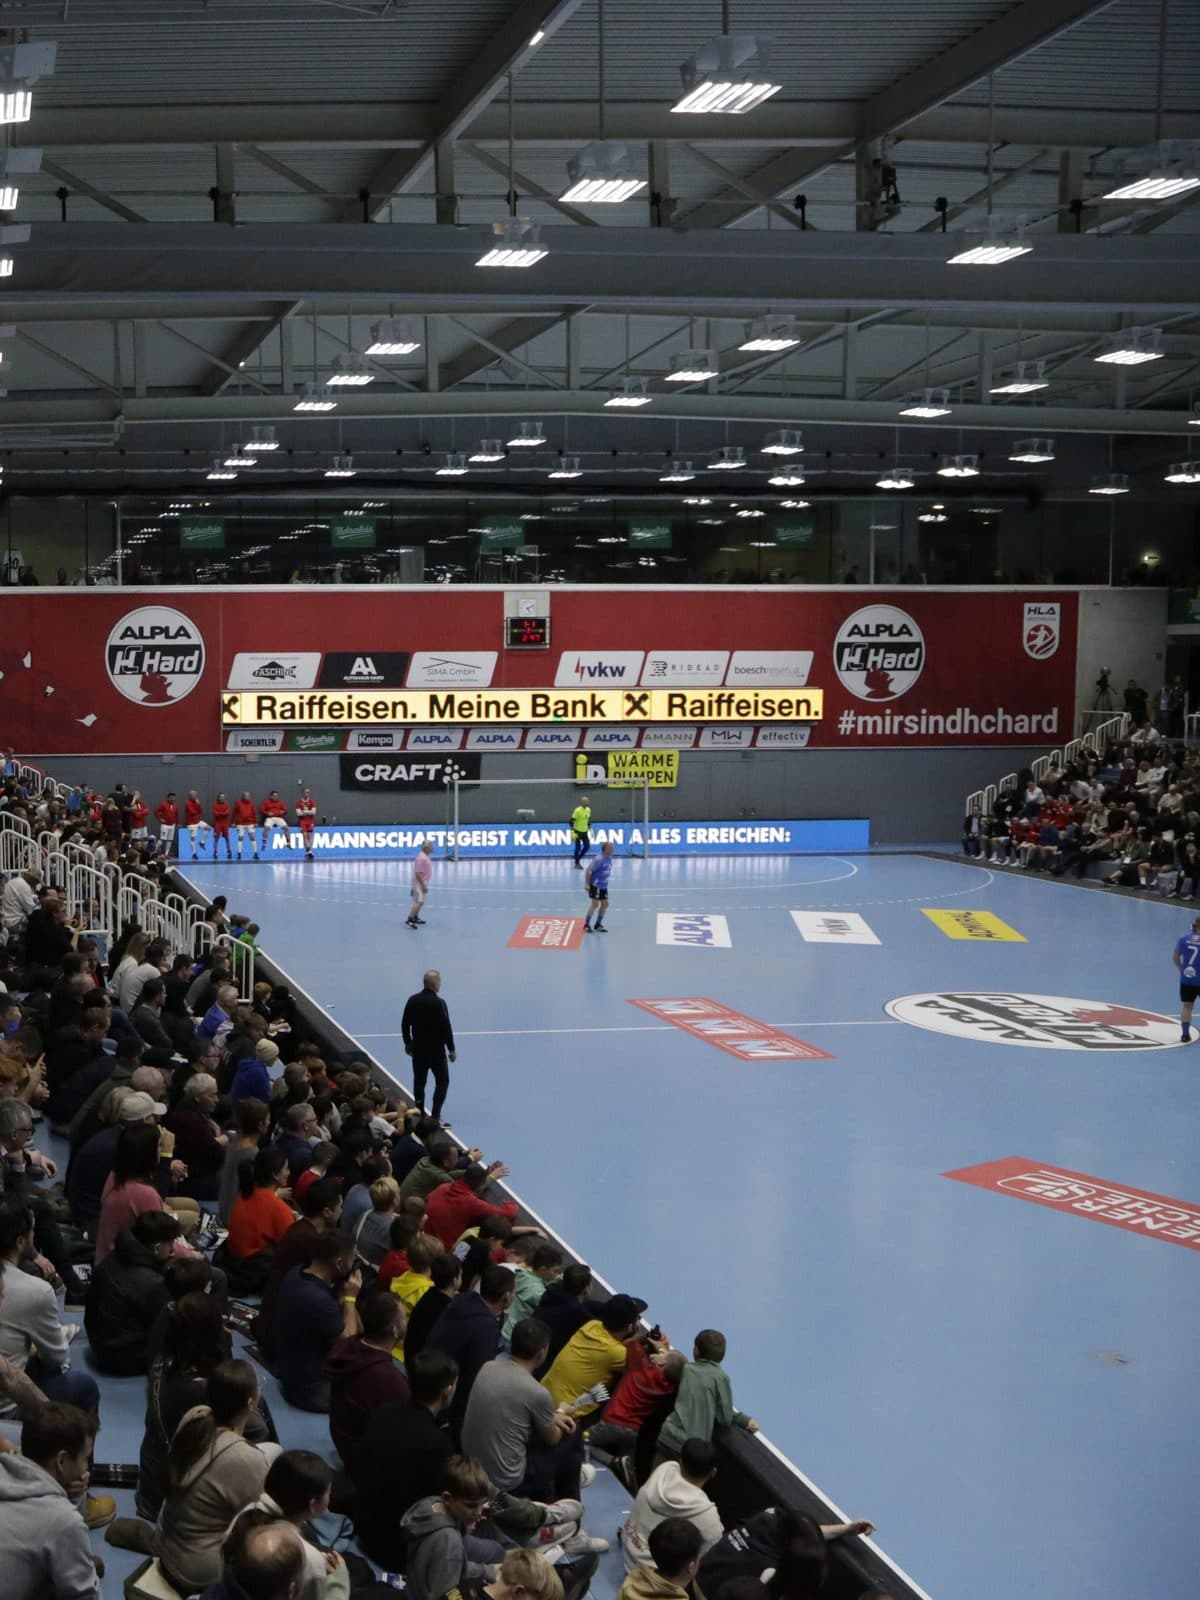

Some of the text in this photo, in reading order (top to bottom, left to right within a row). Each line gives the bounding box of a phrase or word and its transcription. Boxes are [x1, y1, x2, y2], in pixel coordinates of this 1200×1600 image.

[1027, 606, 1057, 615] HLA
[119, 625, 192, 640] ALPLA
[847, 623, 913, 638] ALPLA
[141, 650, 200, 673] Hard
[866, 647, 920, 669] Hard
[427, 668, 476, 676] SIMA GmbH
[586, 660, 626, 678] vkw
[256, 692, 820, 721] Raiffeisen. Meine Bank Raiffeisen.
[837, 707, 1059, 736] #mirsindhchard
[358, 734, 393, 746] Kempa
[412, 735, 453, 744] ALPLA
[476, 734, 516, 744] ALPLA
[533, 734, 573, 743] ALPLA
[592, 733, 632, 743] ALPLA
[644, 733, 693, 741] AMANN
[711, 730, 742, 740] MW
[762, 731, 806, 741] effectiv
[612, 751, 674, 768] WÄRME
[354, 763, 442, 782] CRAFT
[612, 770, 674, 784] PUMPEN
[312, 829, 509, 849] MANNSCHAFTSGEIST
[514, 828, 572, 846] KANN
[687, 827, 791, 844] ERREICHEN:
[1187, 945, 1199, 965] 7
[914, 999, 1054, 1043] ALPLA
[1071, 1200, 1200, 1244] ENER
